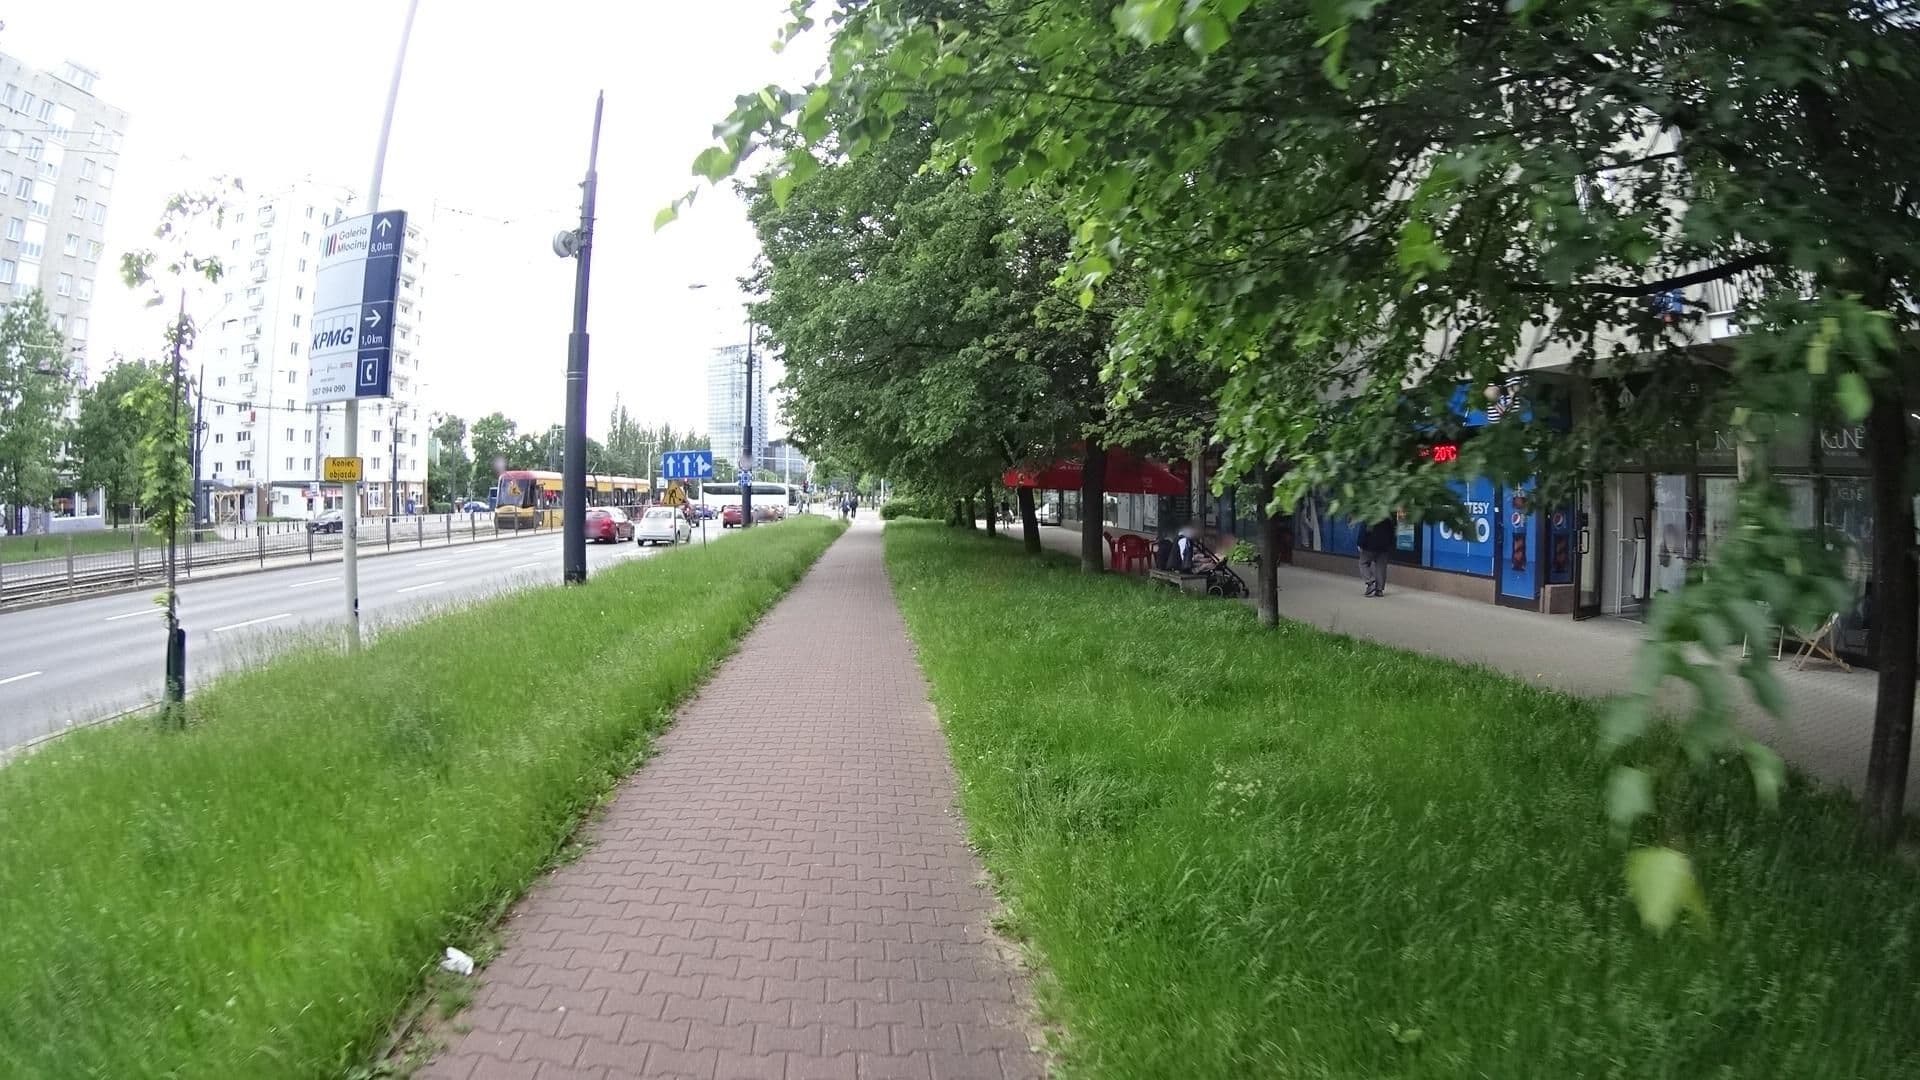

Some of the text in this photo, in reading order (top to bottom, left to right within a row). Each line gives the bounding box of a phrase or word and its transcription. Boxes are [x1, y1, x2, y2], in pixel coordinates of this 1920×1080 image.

[338, 226, 368, 241] Galeria
[312, 326, 354, 350] KPMG
[333, 384, 346, 393] 090
[332, 459, 355, 468] Koniec
[329, 469, 357, 480] objazdu
